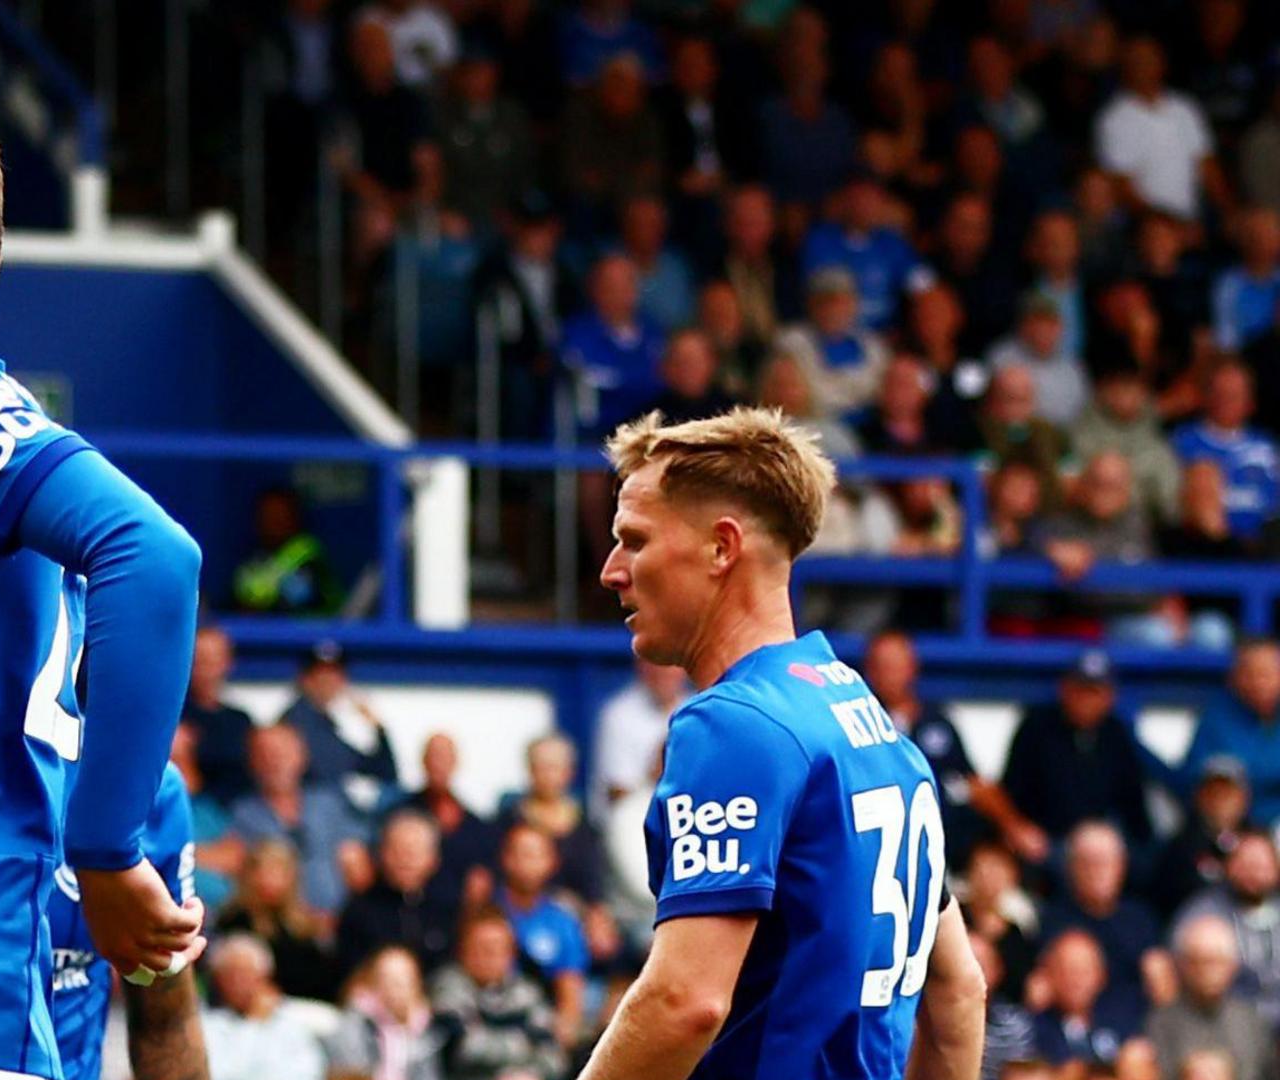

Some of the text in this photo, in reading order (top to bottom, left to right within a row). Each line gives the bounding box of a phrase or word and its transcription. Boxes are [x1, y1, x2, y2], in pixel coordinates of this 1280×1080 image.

[666, 793, 758, 839] Bee
[672, 833, 751, 882] Bu.
[851, 780, 946, 1008] 30
